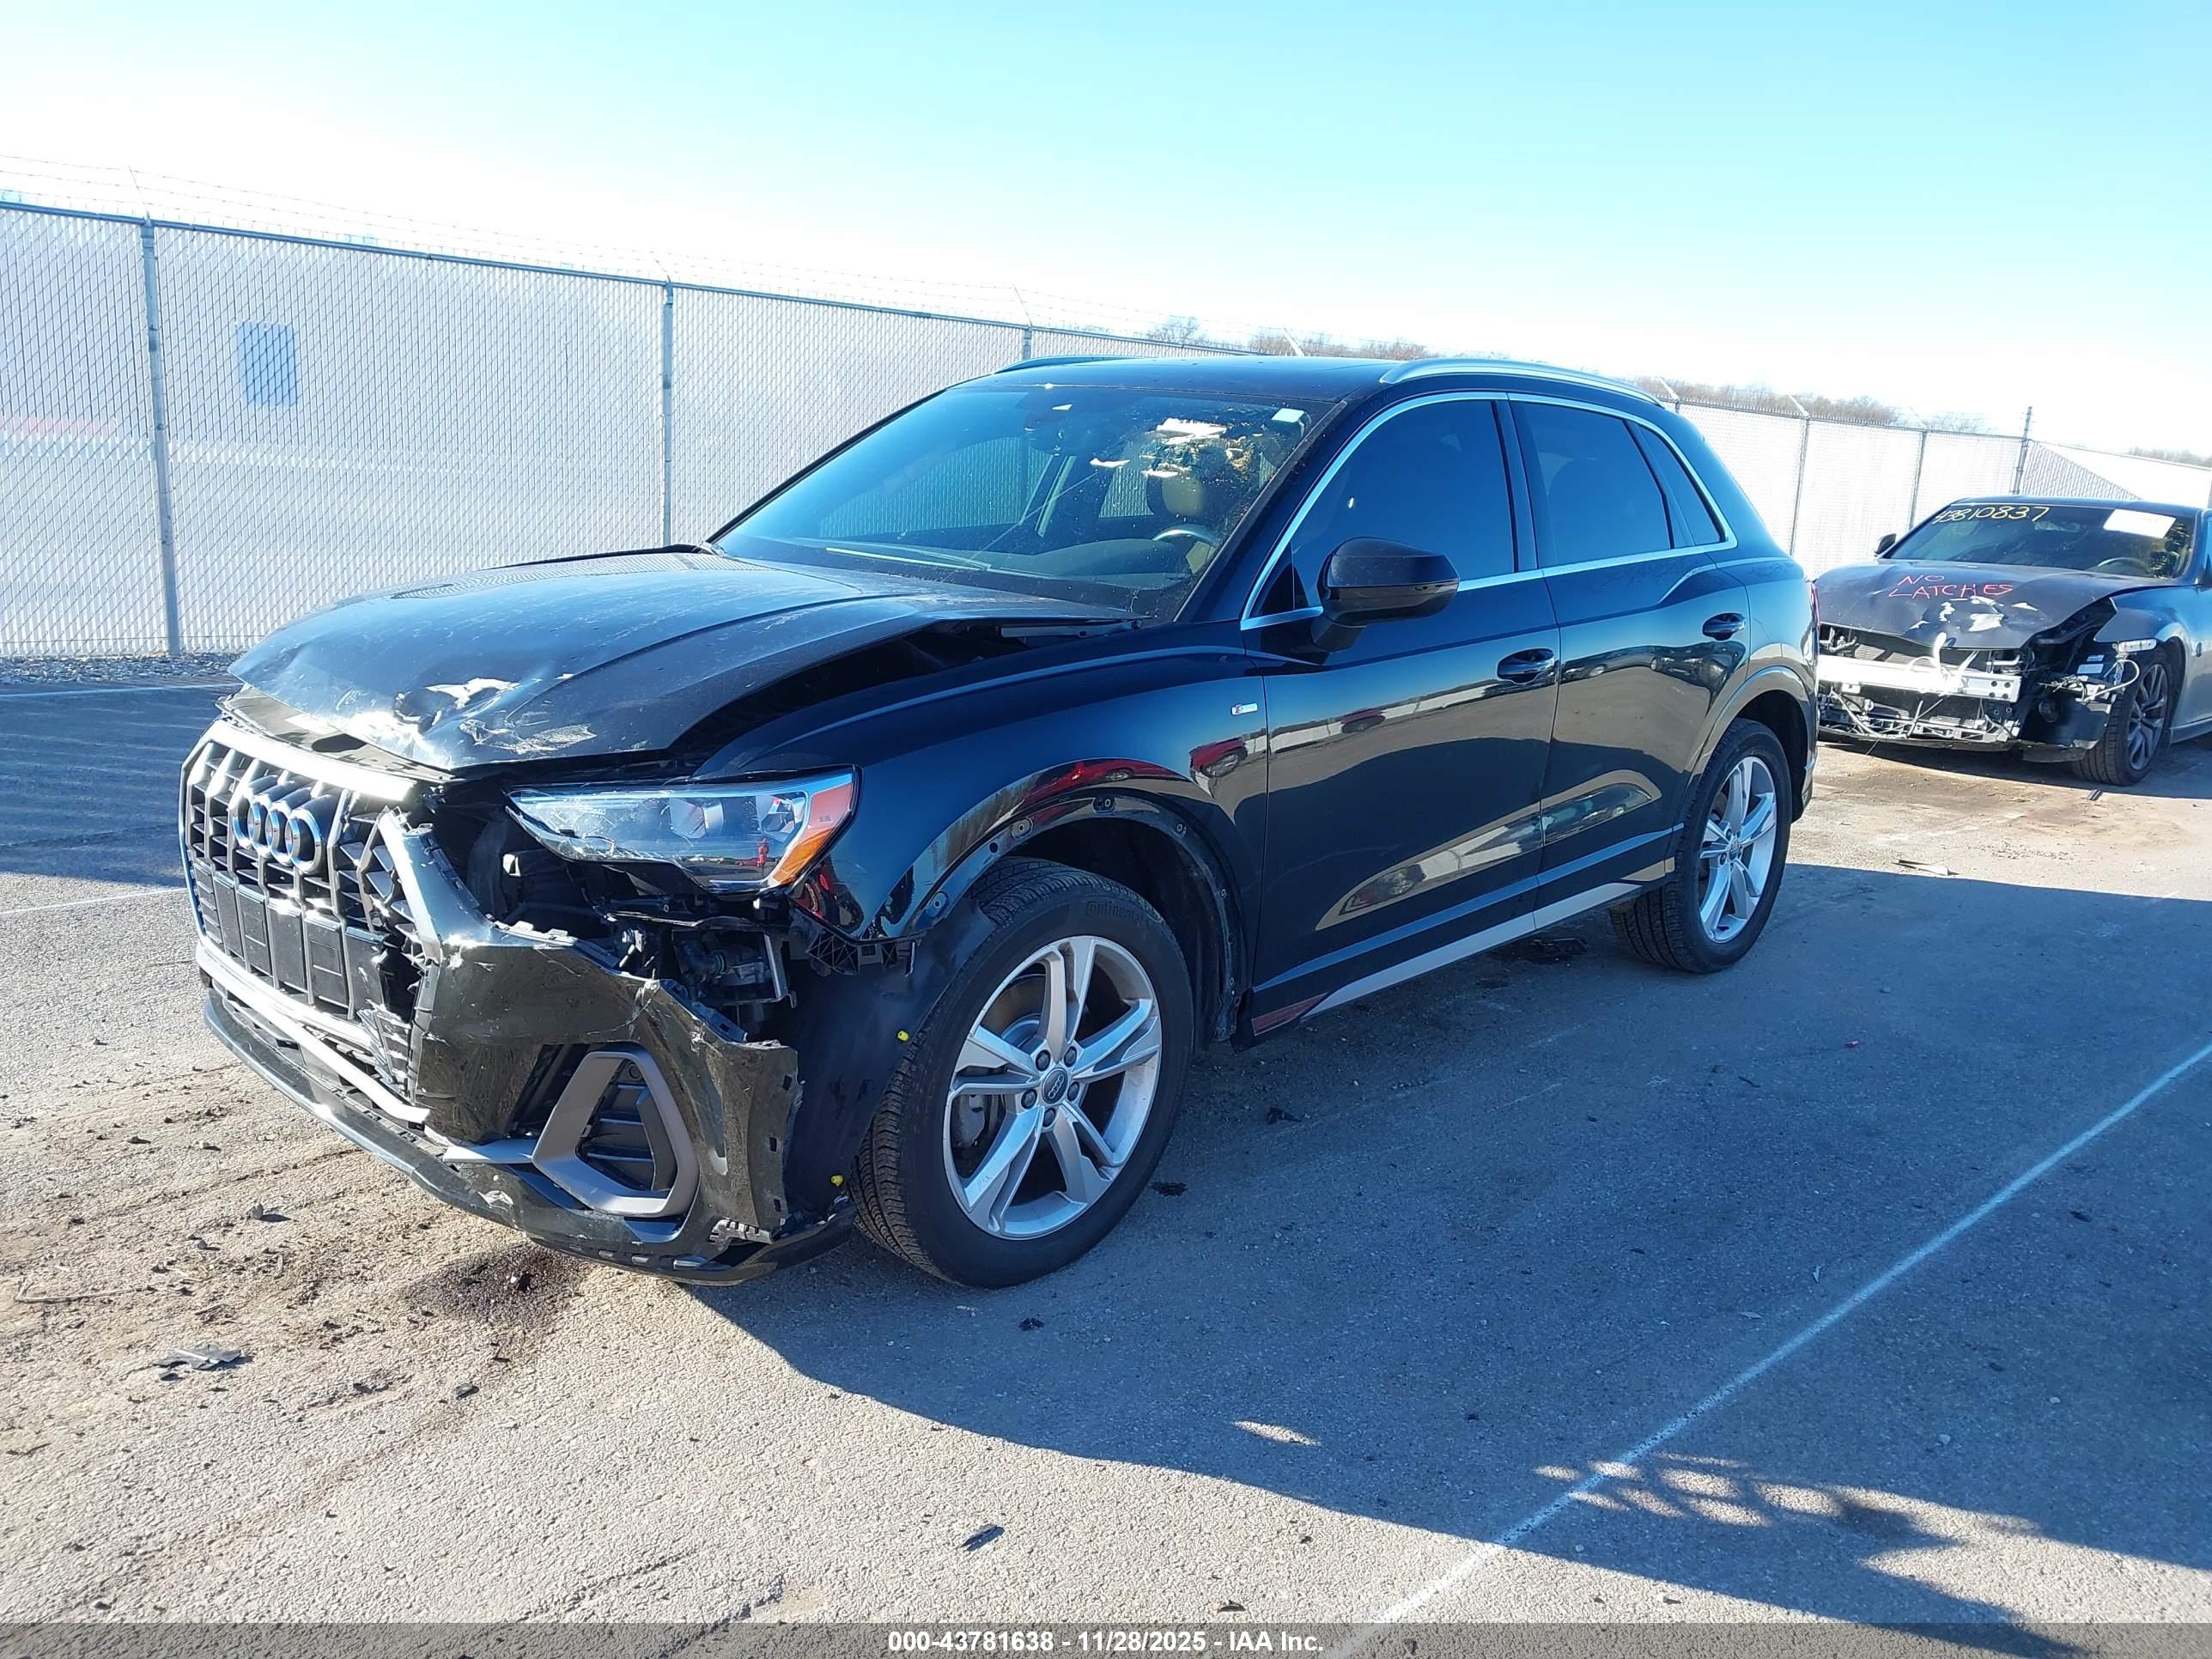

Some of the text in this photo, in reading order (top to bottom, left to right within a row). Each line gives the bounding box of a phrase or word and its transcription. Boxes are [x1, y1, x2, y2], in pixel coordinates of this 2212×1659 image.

[1898, 574, 1945, 586] NO
[1888, 583, 2014, 599] LATCHES
[1085, 900, 1143, 927] Continental
